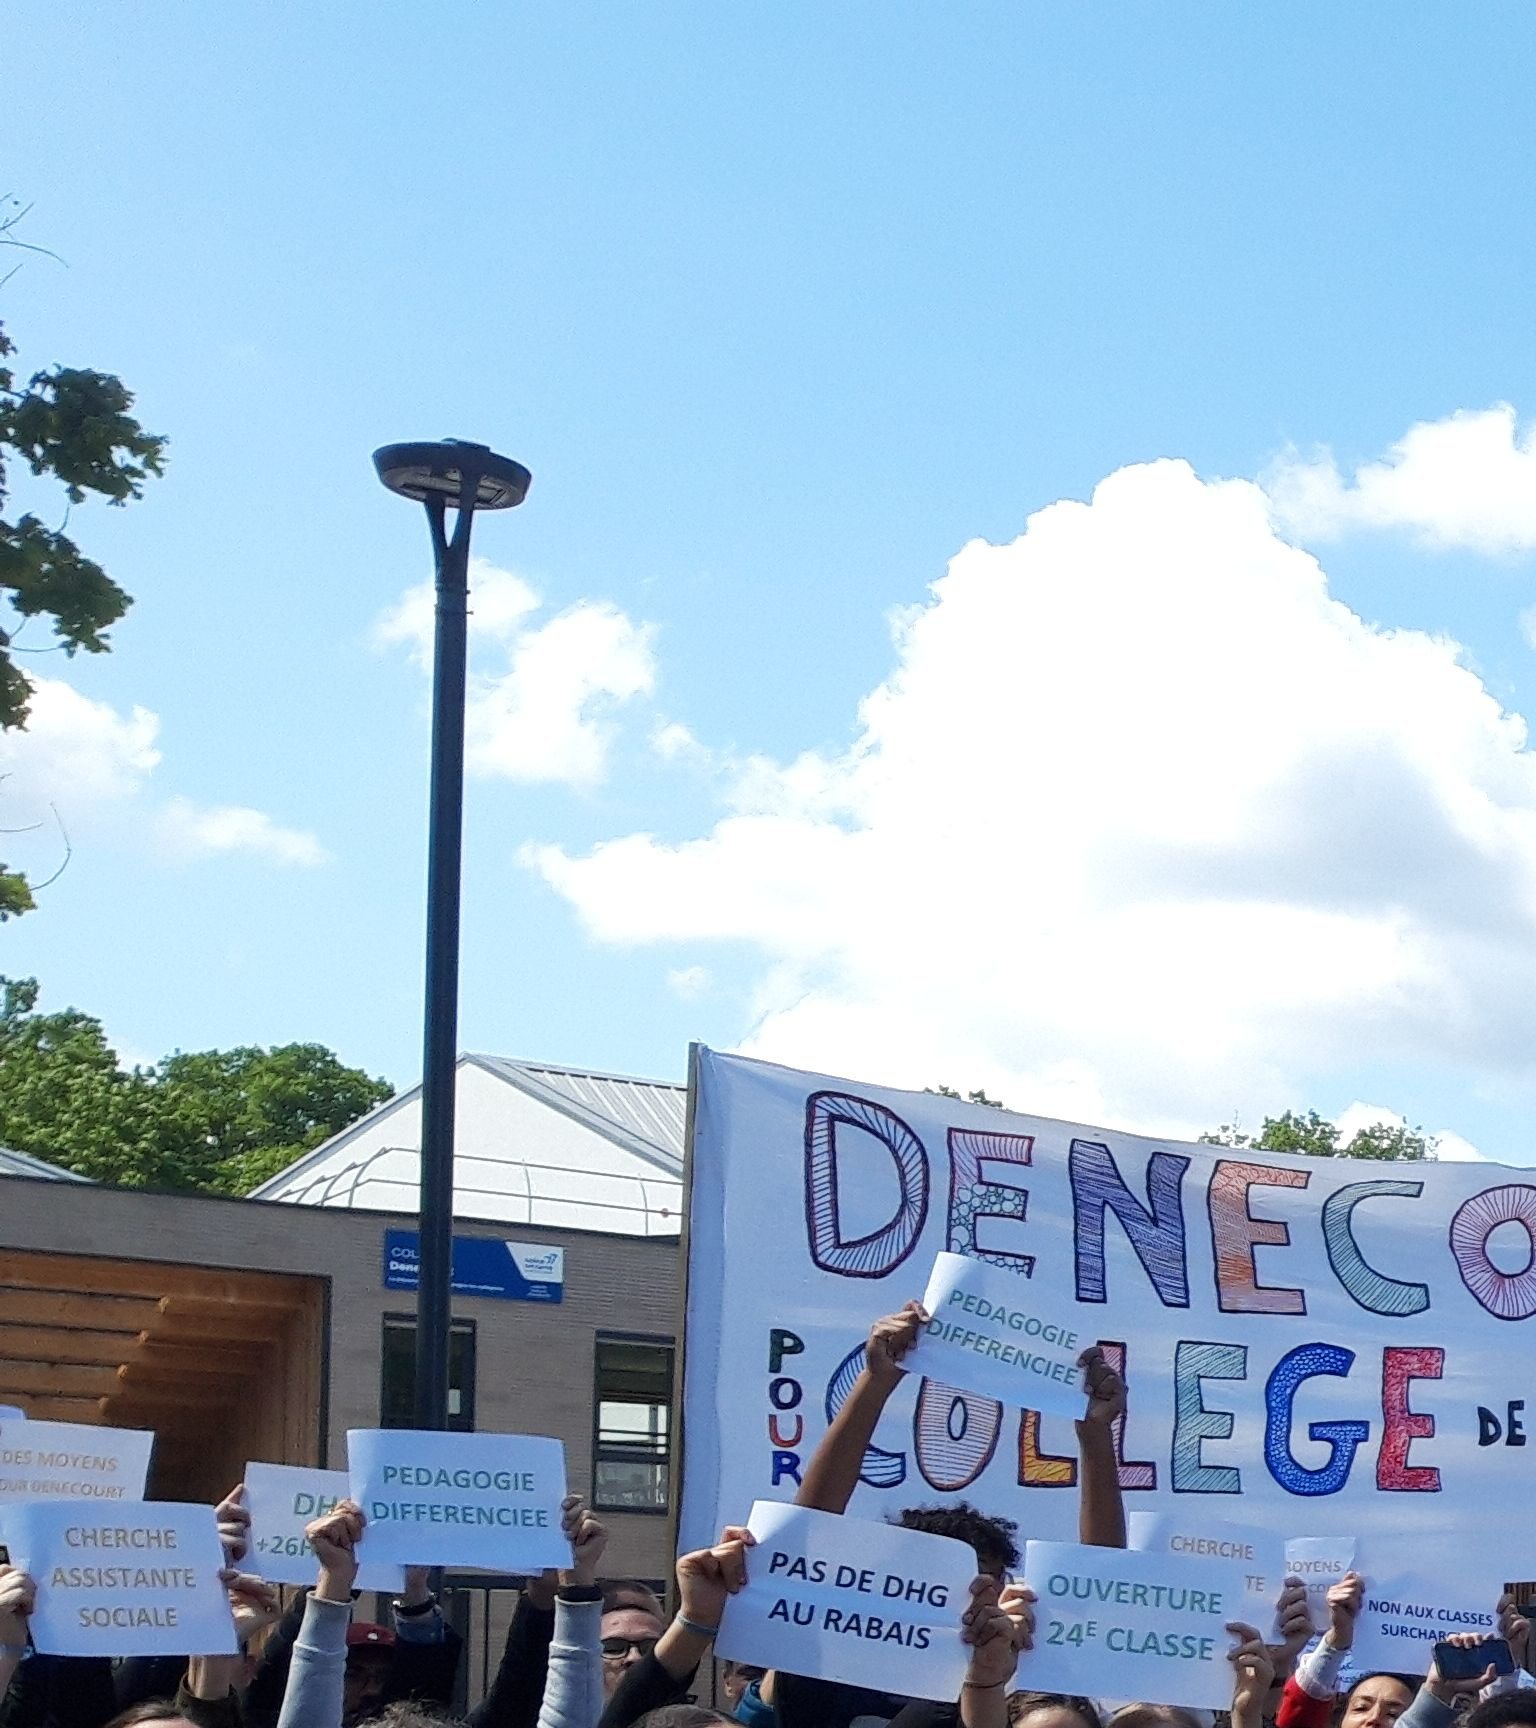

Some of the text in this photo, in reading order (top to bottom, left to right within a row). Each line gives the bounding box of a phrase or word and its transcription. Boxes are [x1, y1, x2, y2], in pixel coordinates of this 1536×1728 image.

[949, 1289, 1079, 1350] PEDAGOGIE
[926, 1318, 1079, 1385] DIFFERENCIEE
[768, 1329, 805, 1486] POUR
[1477, 1400, 1526, 1447] DE
[37, 1452, 119, 1471] MOYENS
[31, 1480, 125, 1499] DENECOURT
[383, 1465, 535, 1492] PEDAGOGIE
[293, 1492, 342, 1517] DH
[373, 1501, 549, 1528] DIFFERENCIEE
[64, 1527, 177, 1550] CHERCHE
[1170, 1535, 1254, 1560] CHERCHE
[51, 1567, 197, 1588] ASSISTANTE
[768, 1551, 949, 1608] PAS DE DHG
[1047, 1573, 1223, 1614] OUVERTURE
[78, 1606, 178, 1628] SOCIALE
[768, 1598, 932, 1650] AU RABAIS
[1368, 1599, 1494, 1627] NON AUX CLASSES
[1106, 1626, 1216, 1661] CLASSE
